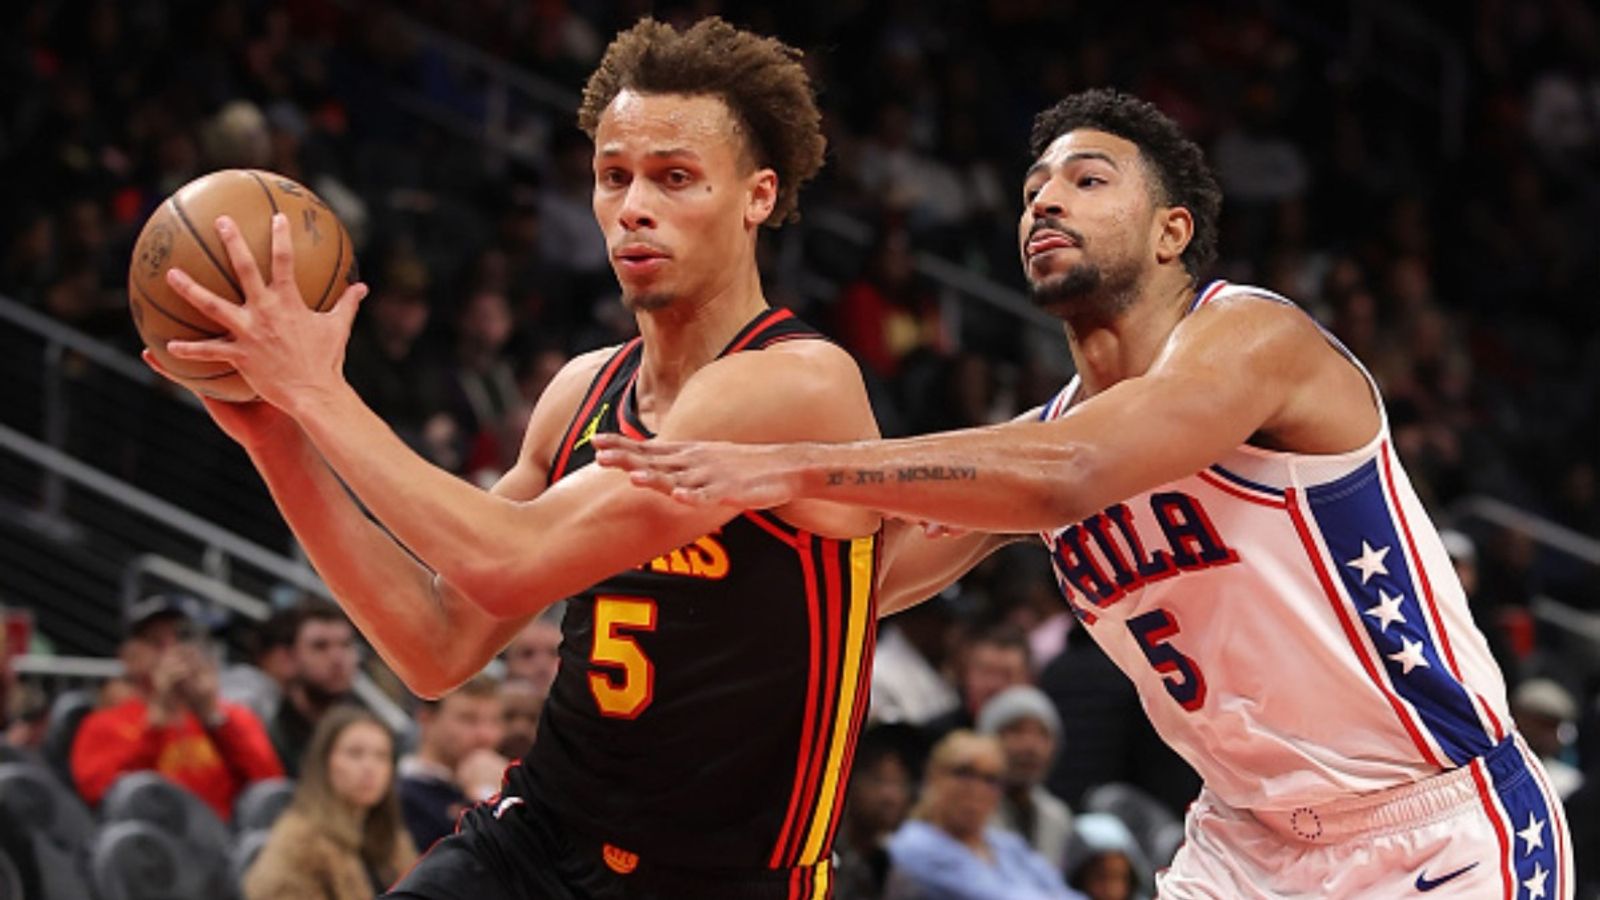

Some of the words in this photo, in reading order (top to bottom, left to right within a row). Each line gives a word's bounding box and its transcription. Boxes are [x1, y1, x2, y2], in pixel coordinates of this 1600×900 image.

[1041, 491, 1240, 626] HILA
[588, 594, 659, 720] 5
[1125, 608, 1207, 712] 5
